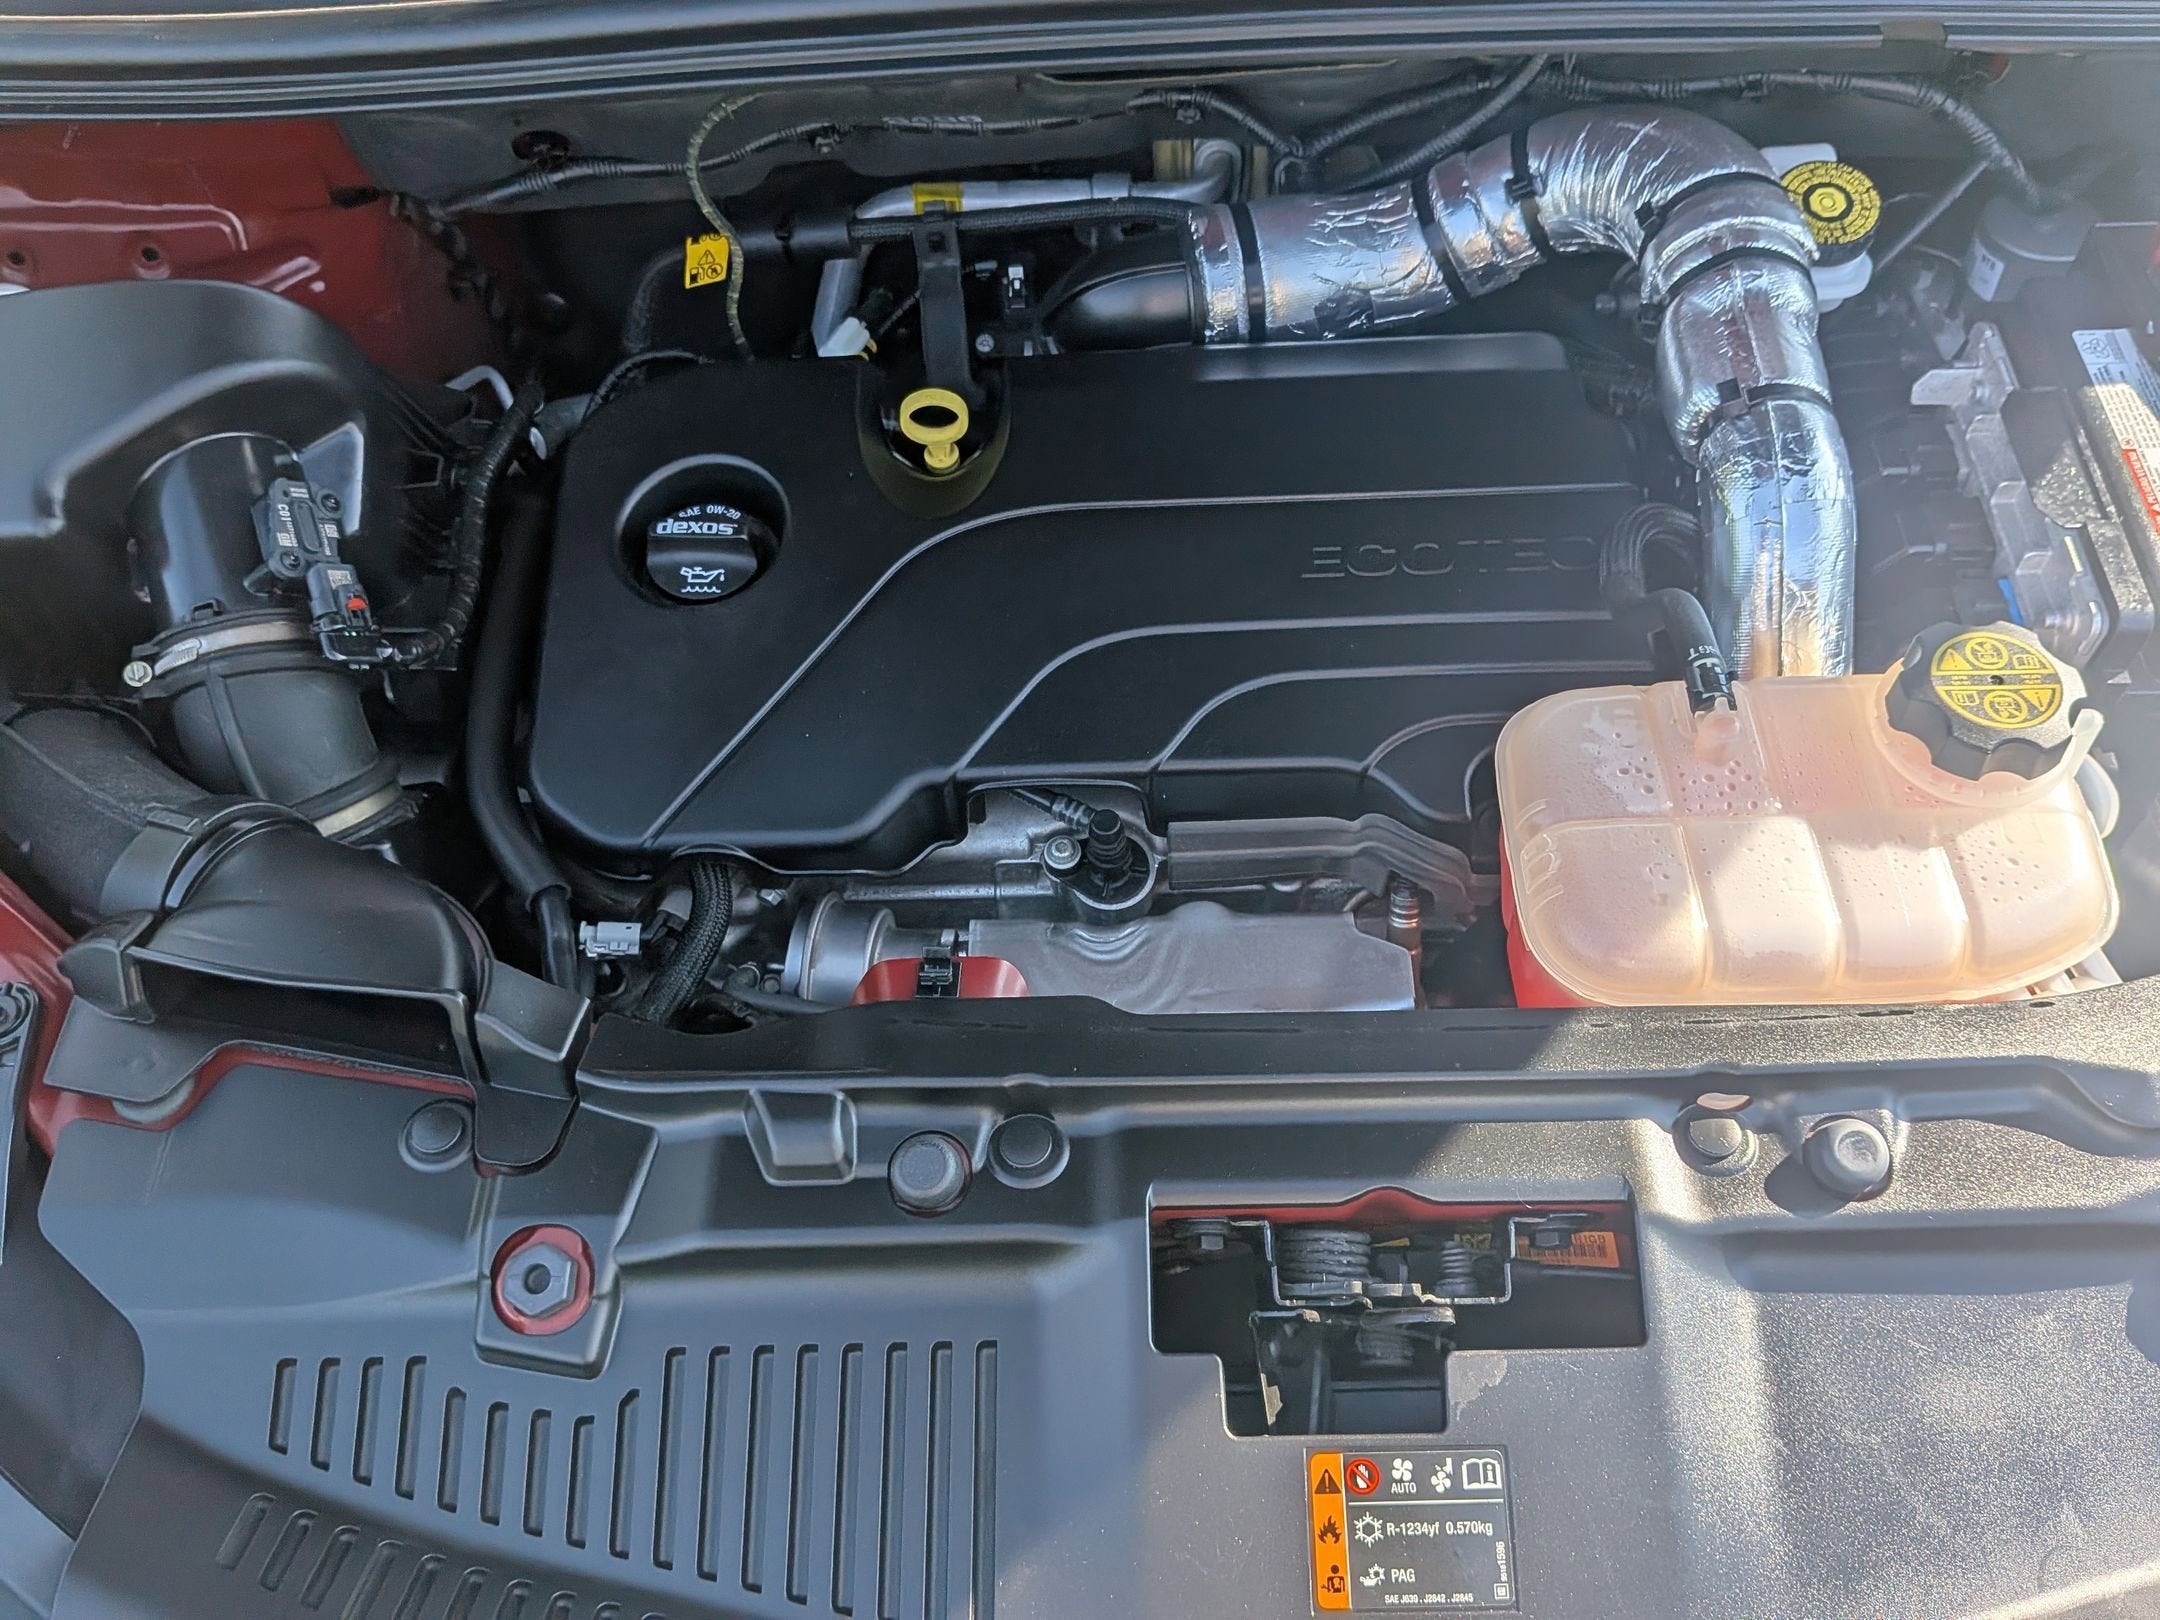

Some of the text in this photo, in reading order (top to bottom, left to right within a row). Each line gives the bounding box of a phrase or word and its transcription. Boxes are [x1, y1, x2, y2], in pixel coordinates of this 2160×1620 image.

[679, 505, 741, 520] SAE 0W-20
[656, 518, 735, 535] dexos
[1391, 1482, 1417, 1494] AUTO
[1386, 1520, 1494, 1539] R-1234yf 0.570kg
[1391, 1568, 1416, 1583] PAG
[1384, 1594, 1399, 1605] SAE
[1400, 1594, 1419, 1604] J639
